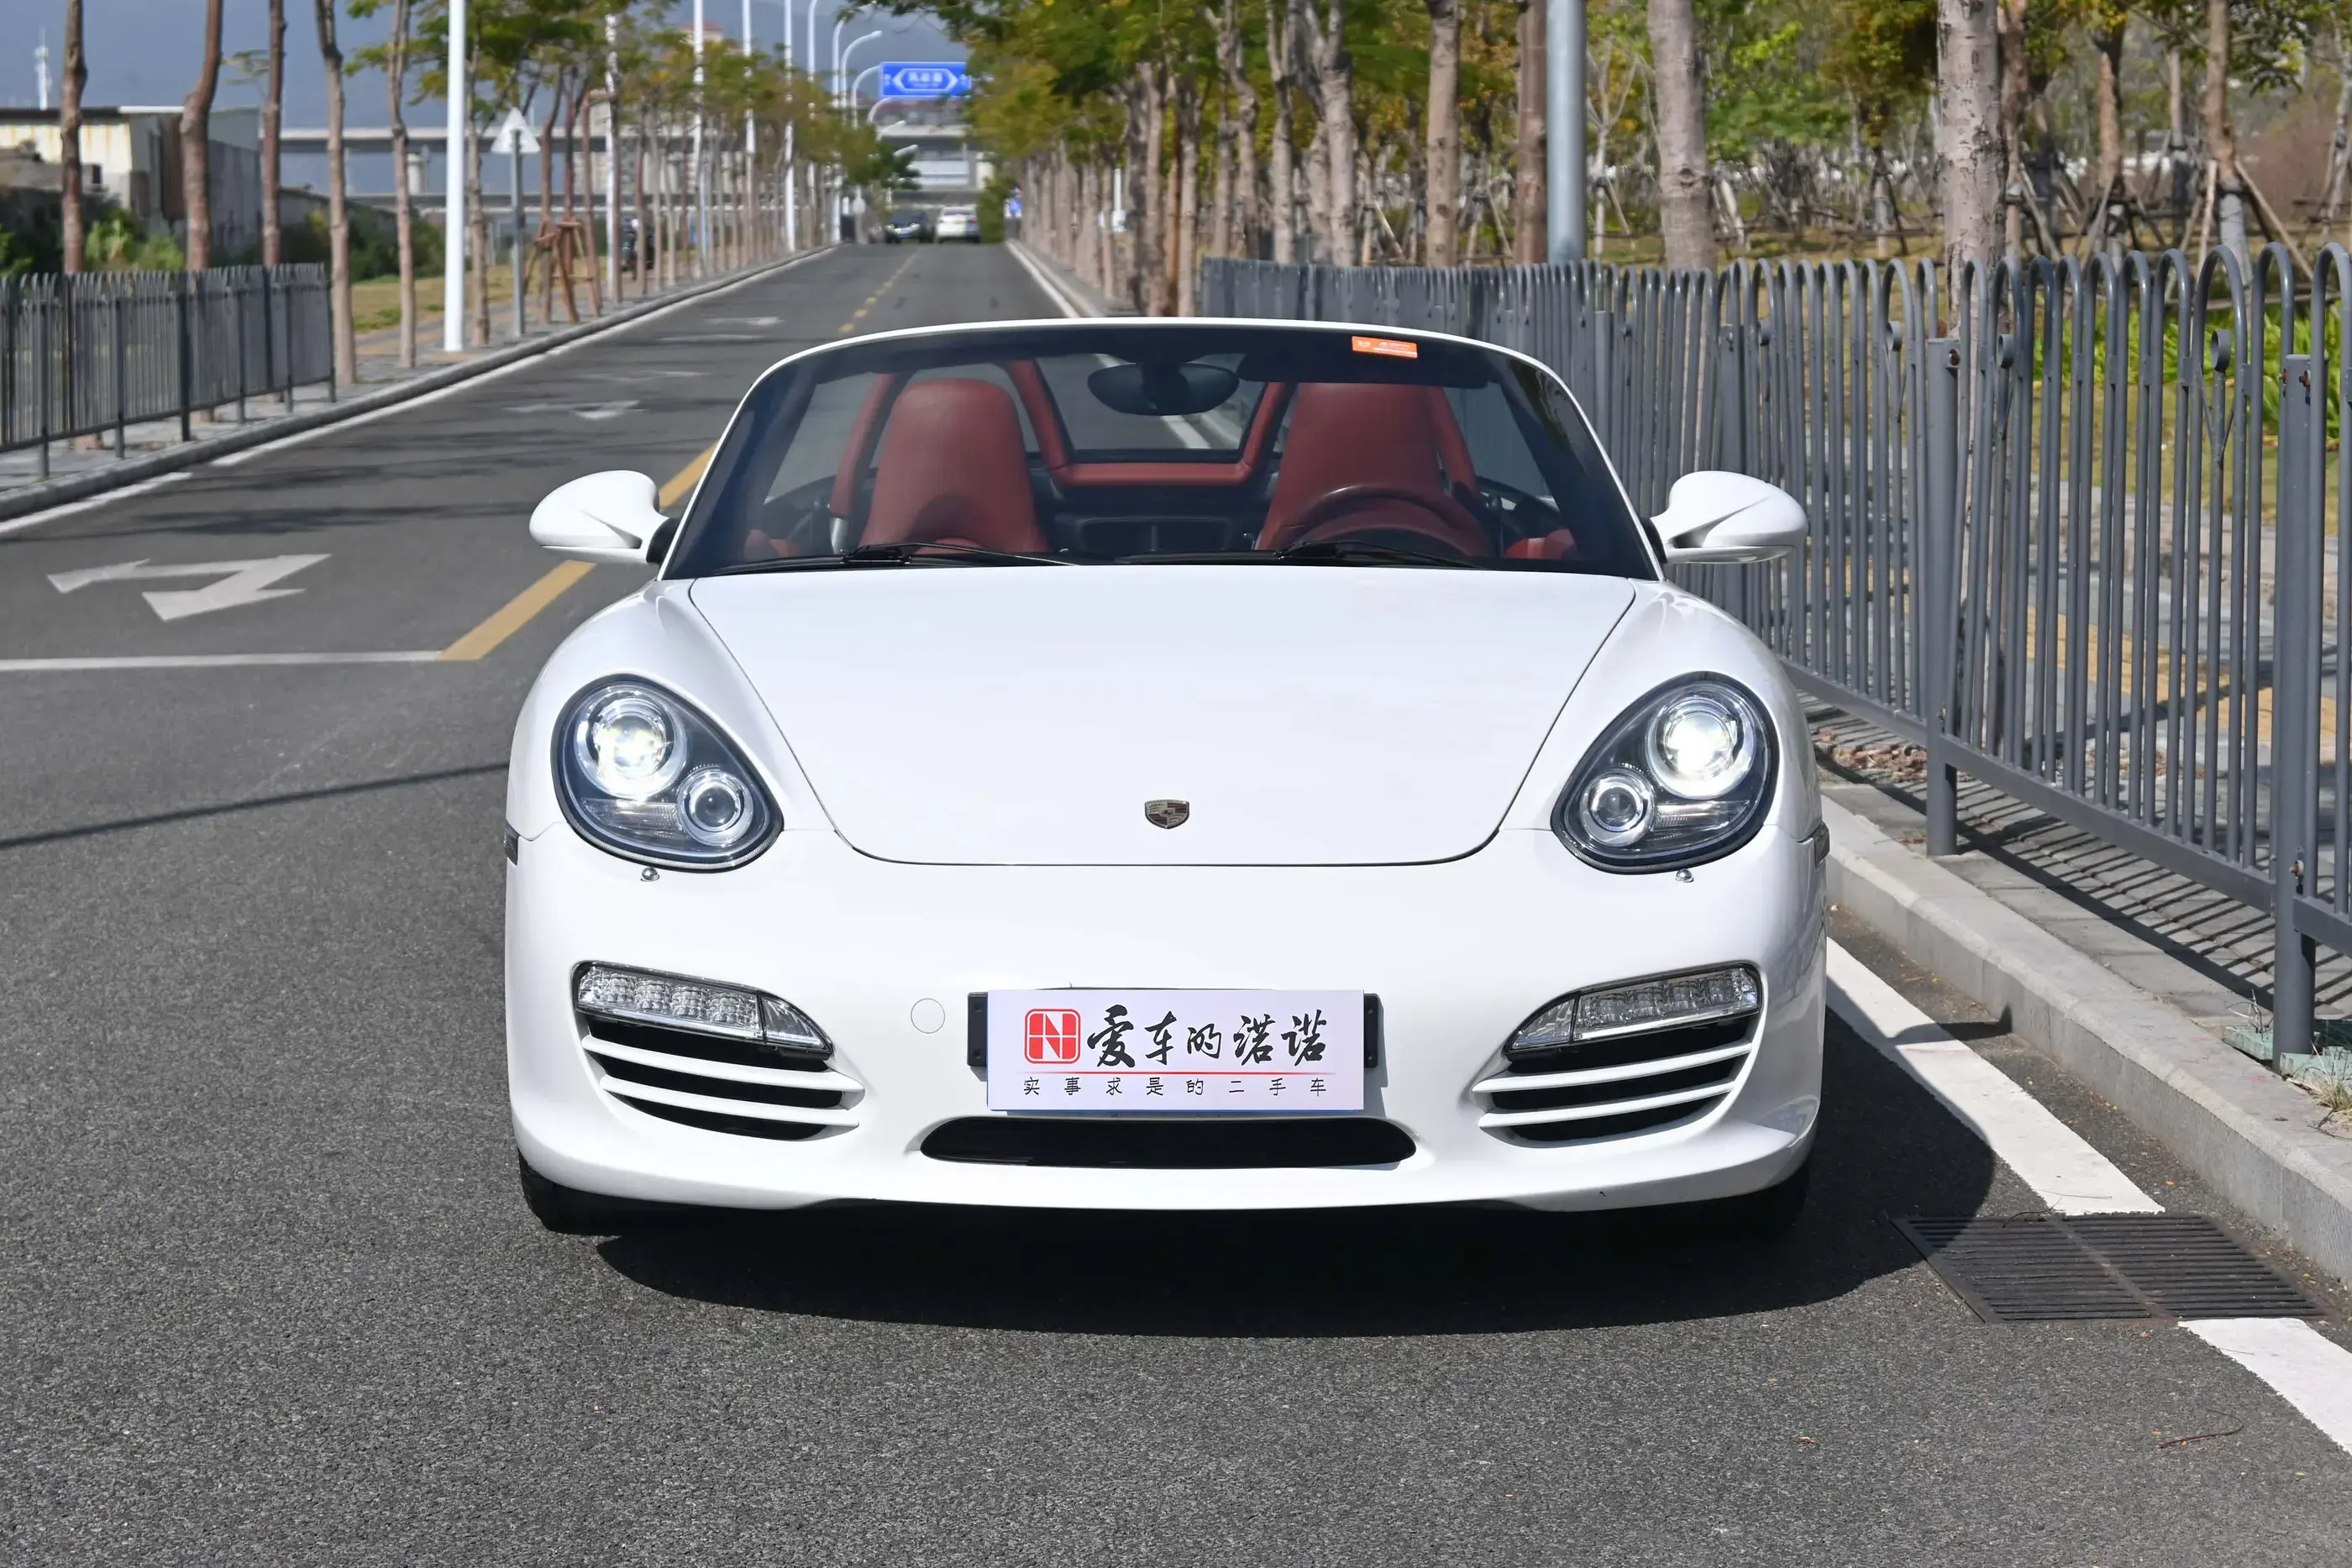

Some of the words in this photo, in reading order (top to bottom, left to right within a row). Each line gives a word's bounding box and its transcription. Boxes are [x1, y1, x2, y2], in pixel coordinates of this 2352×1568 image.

[1087, 1004, 1327, 1067] 爱车的诺诺
[1023, 1077, 1326, 1097] 实事求是的二手车
